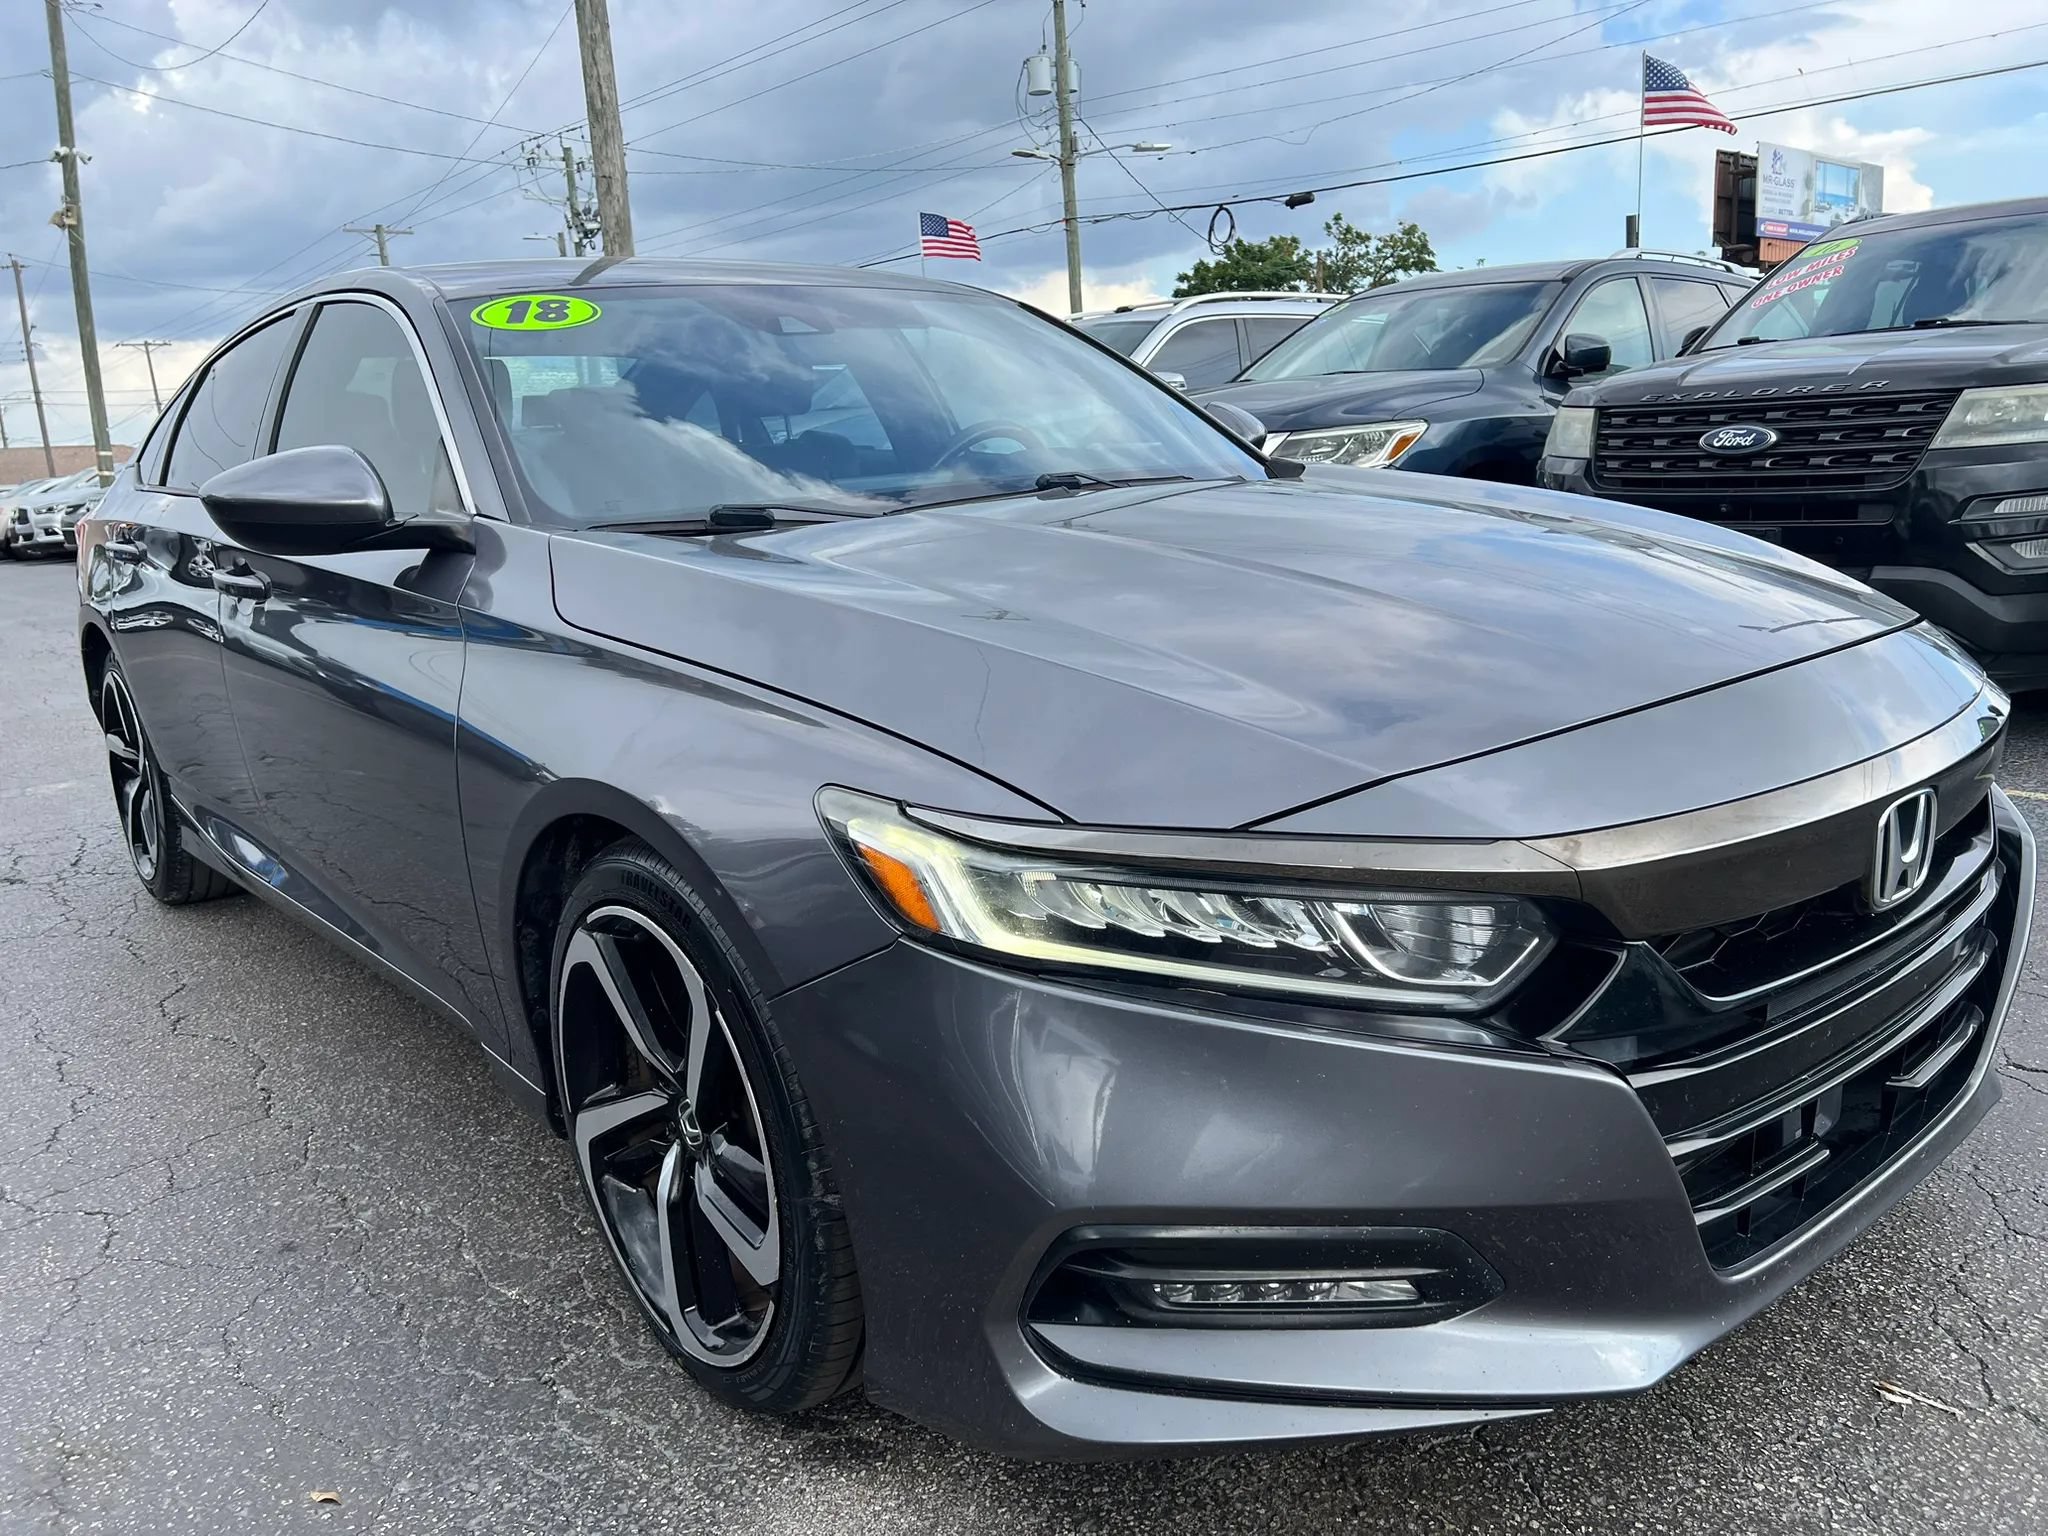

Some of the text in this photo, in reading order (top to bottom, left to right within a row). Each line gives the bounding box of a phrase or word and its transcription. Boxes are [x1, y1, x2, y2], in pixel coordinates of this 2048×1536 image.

[1766, 246, 1858, 289] LOW MILES
[1752, 265, 1844, 309] ONE OWNER
[504, 299, 571, 324] 18
[1640, 380, 1890, 402] EXPLORER
[1713, 429, 1757, 447] Ford
[621, 869, 692, 932] TRAVELSTAR
